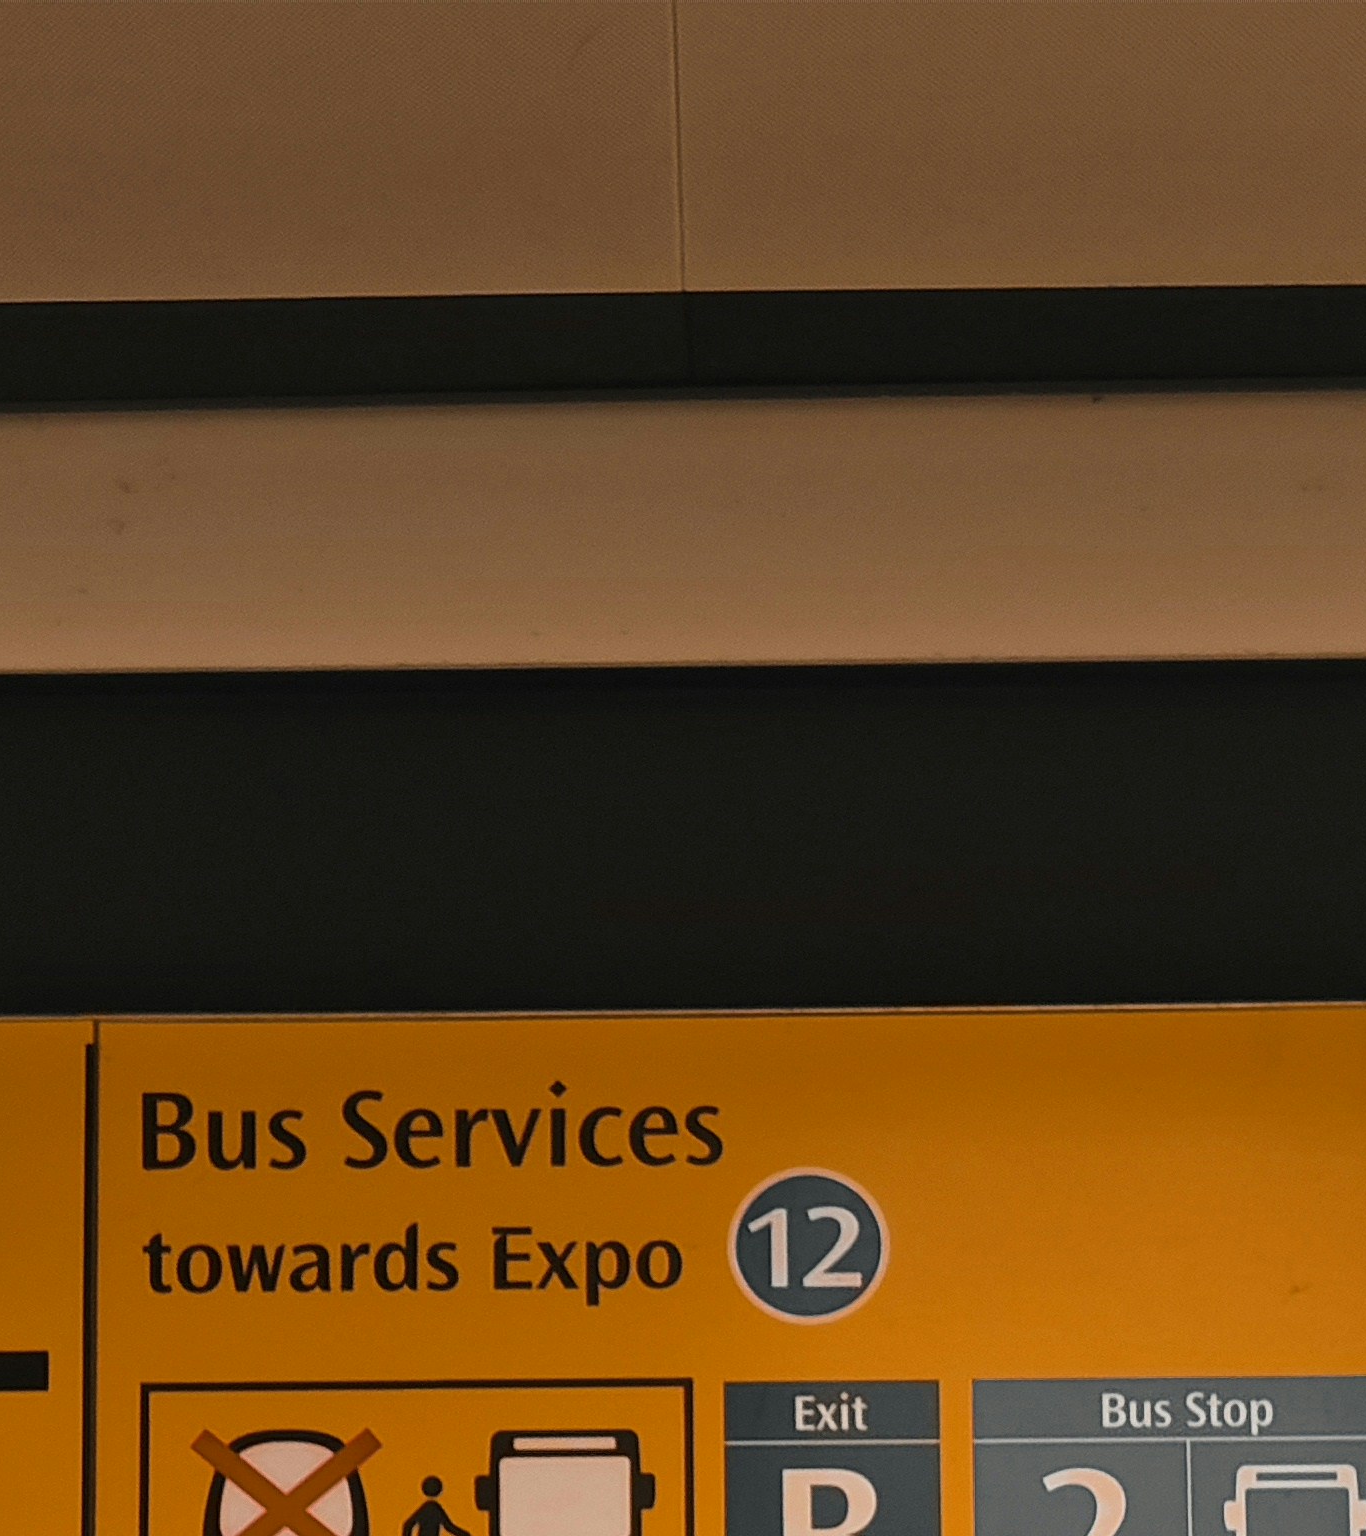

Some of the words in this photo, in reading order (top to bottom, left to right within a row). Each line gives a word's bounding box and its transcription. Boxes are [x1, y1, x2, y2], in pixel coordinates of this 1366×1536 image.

[142, 1093, 307, 1170] Bus
[343, 1081, 724, 1169] Services
[143, 1223, 459, 1293] towards
[493, 1227, 682, 1306] Expo
[747, 1207, 863, 1289] 12
[795, 1391, 868, 1431] Exit
[1101, 1392, 1172, 1429] Bus
[1185, 1391, 1274, 1436] Stop
